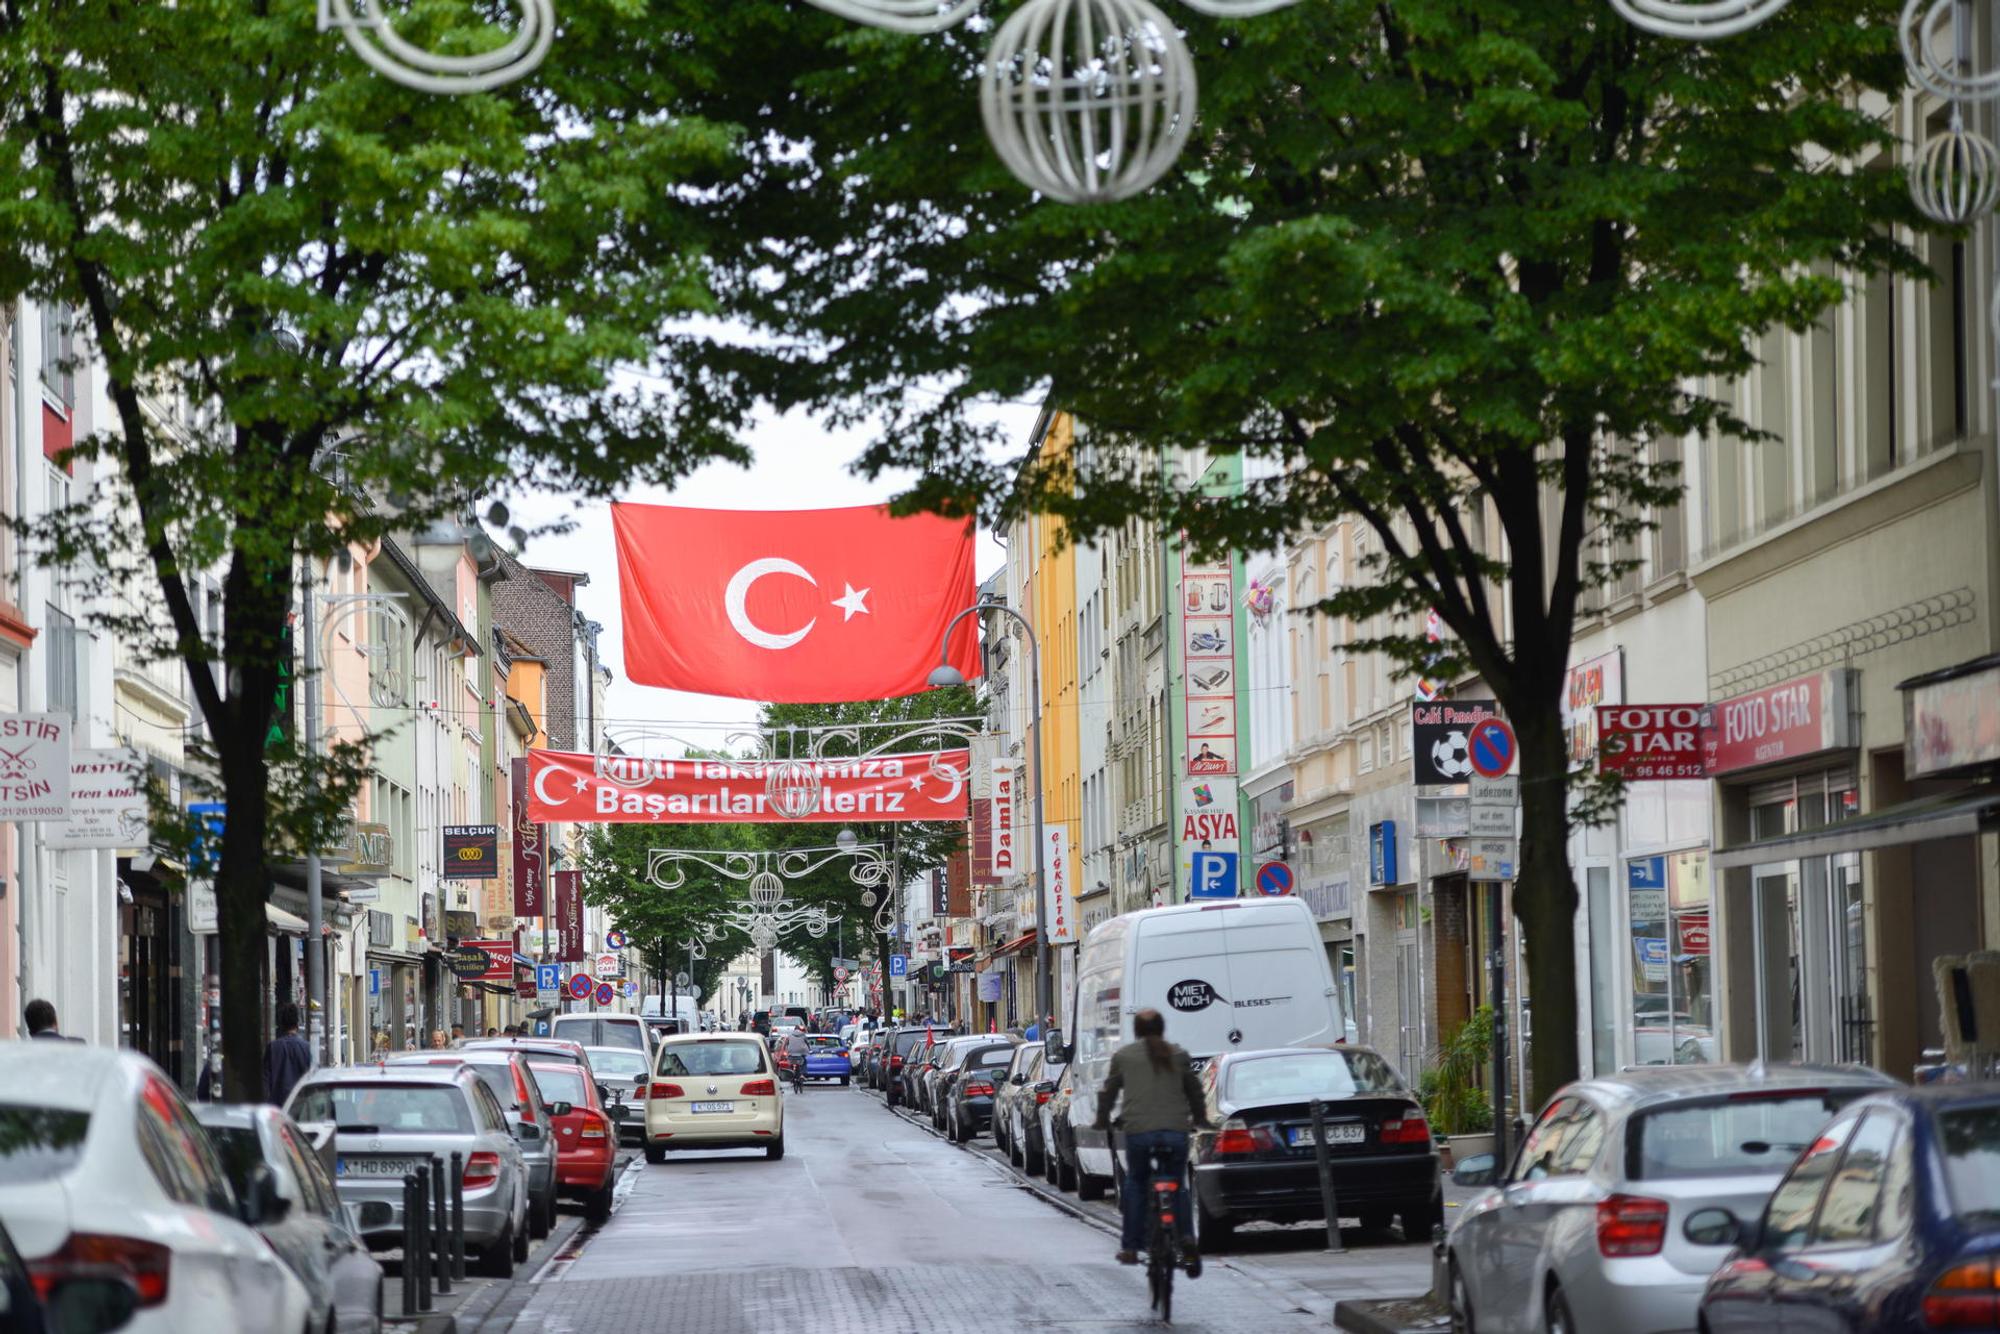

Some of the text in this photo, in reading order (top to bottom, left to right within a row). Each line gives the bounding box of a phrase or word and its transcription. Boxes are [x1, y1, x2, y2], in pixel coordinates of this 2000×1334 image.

[1415, 707, 1441, 725] Café
[1603, 709, 1699, 729] FOTO
[1725, 684, 1811, 744] FOTO STAR
[0, 717, 60, 742] STİR
[1606, 732, 1696, 753] STAR
[1677, 765, 1702, 775] 512
[1475, 786, 1513, 798] Ladezone
[596, 786, 768, 820] Başarılar
[0, 806, 63, 816] 21/26139050
[445, 827, 495, 836] SELÇUK
[996, 780, 1013, 870] Damla
[940, 867, 948, 911] HATAY
[1174, 985, 1207, 997] MIET
[1174, 995, 1210, 1007] MICH
[1234, 999, 1271, 1009] BLESES
[1343, 1125, 1362, 1138] 837
